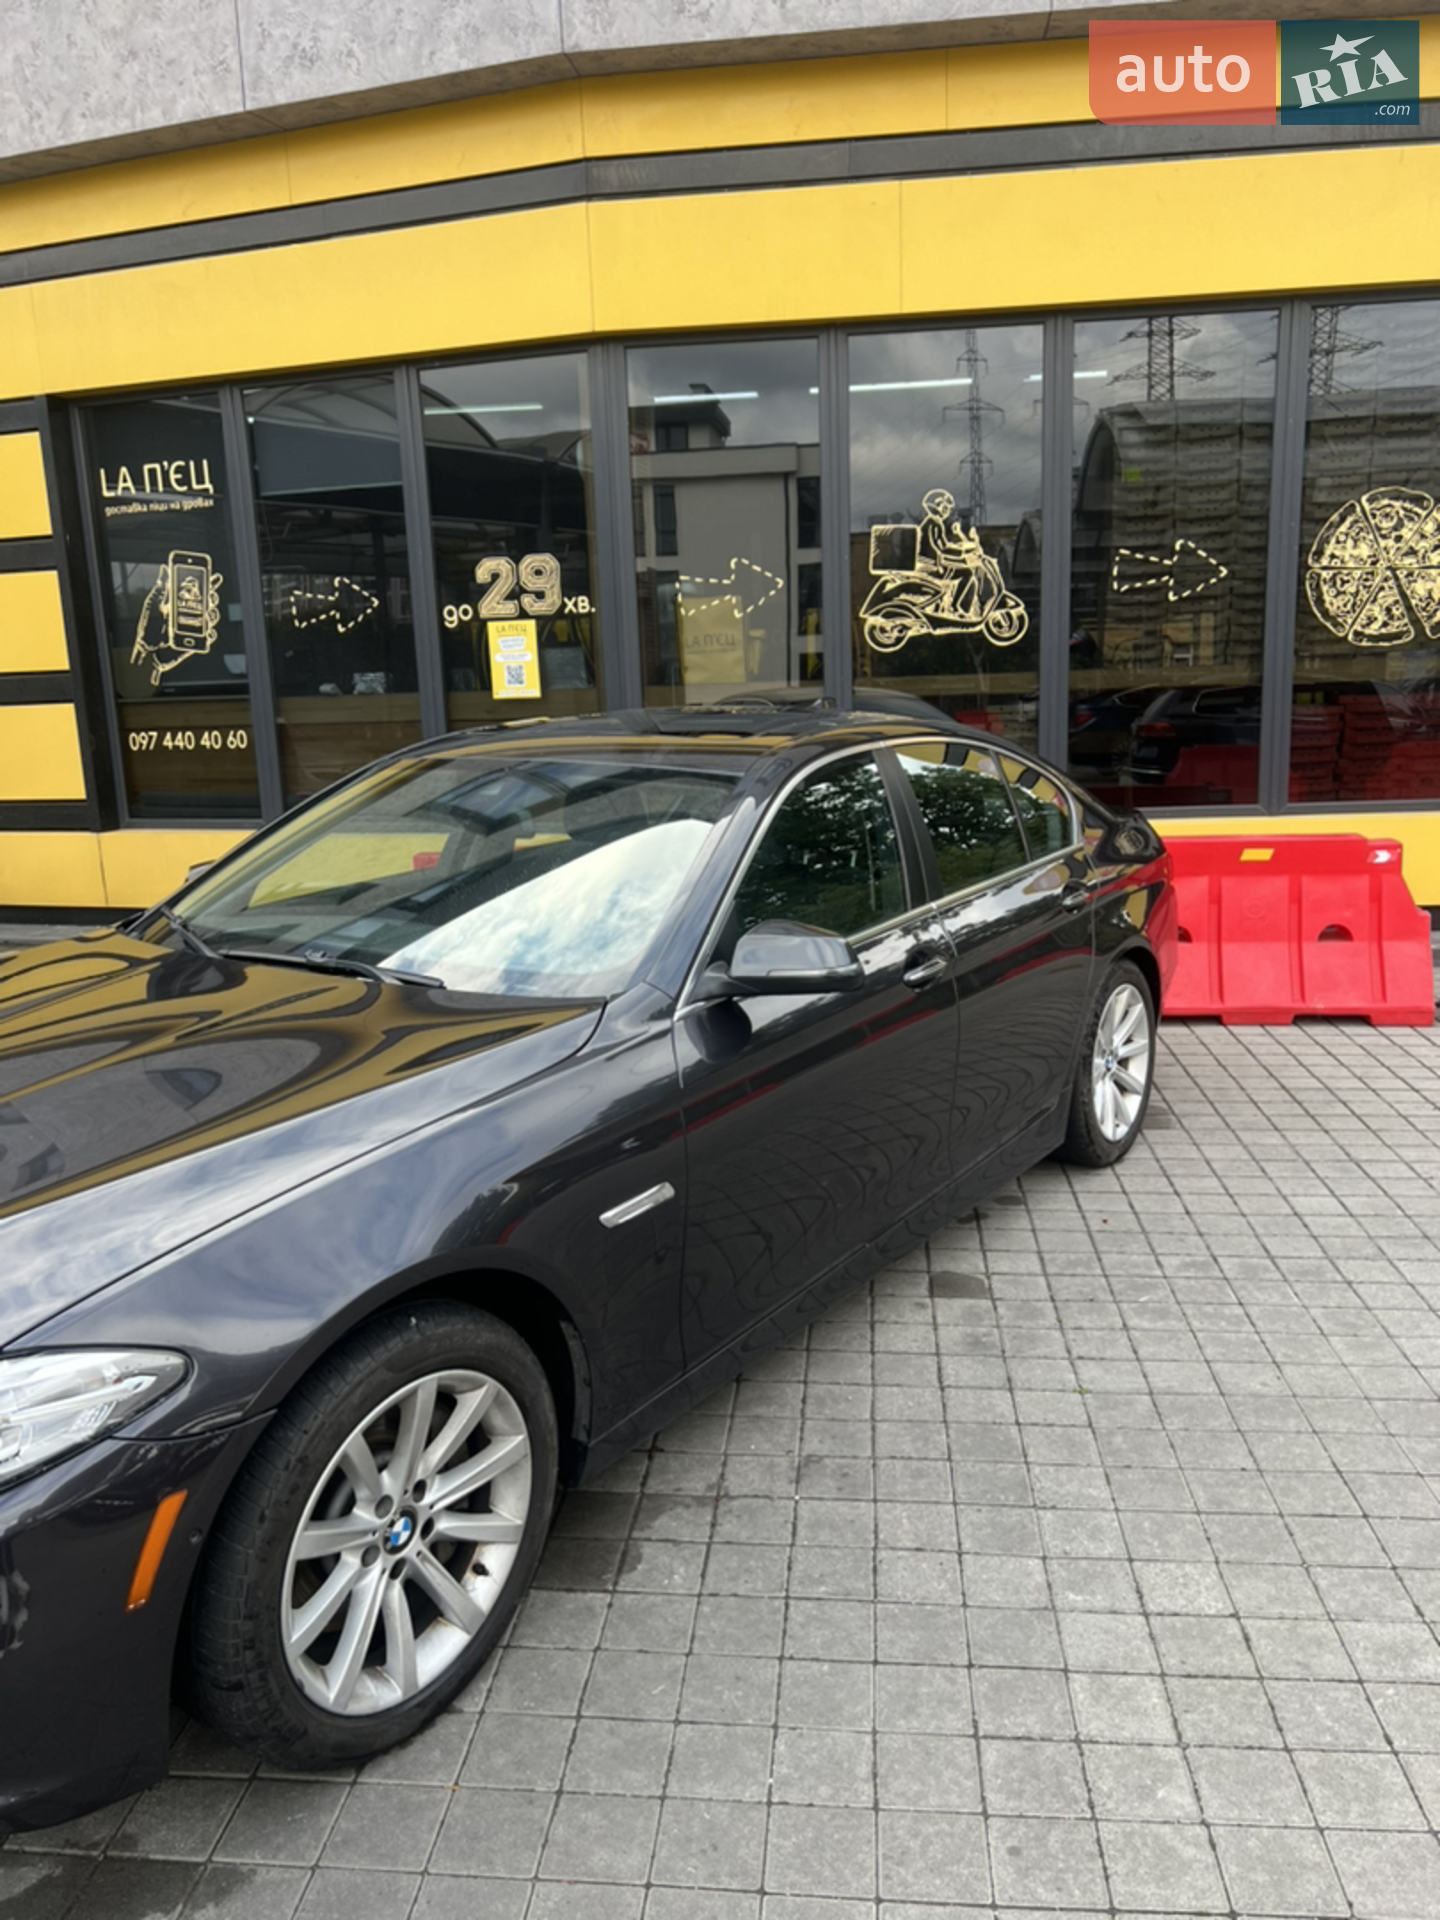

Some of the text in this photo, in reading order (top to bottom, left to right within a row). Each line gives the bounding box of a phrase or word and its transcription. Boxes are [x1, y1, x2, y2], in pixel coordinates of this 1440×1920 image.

[99, 465, 136, 498] LA
[474, 552, 563, 619] 29
[128, 730, 248, 751] 097 440 40 60
